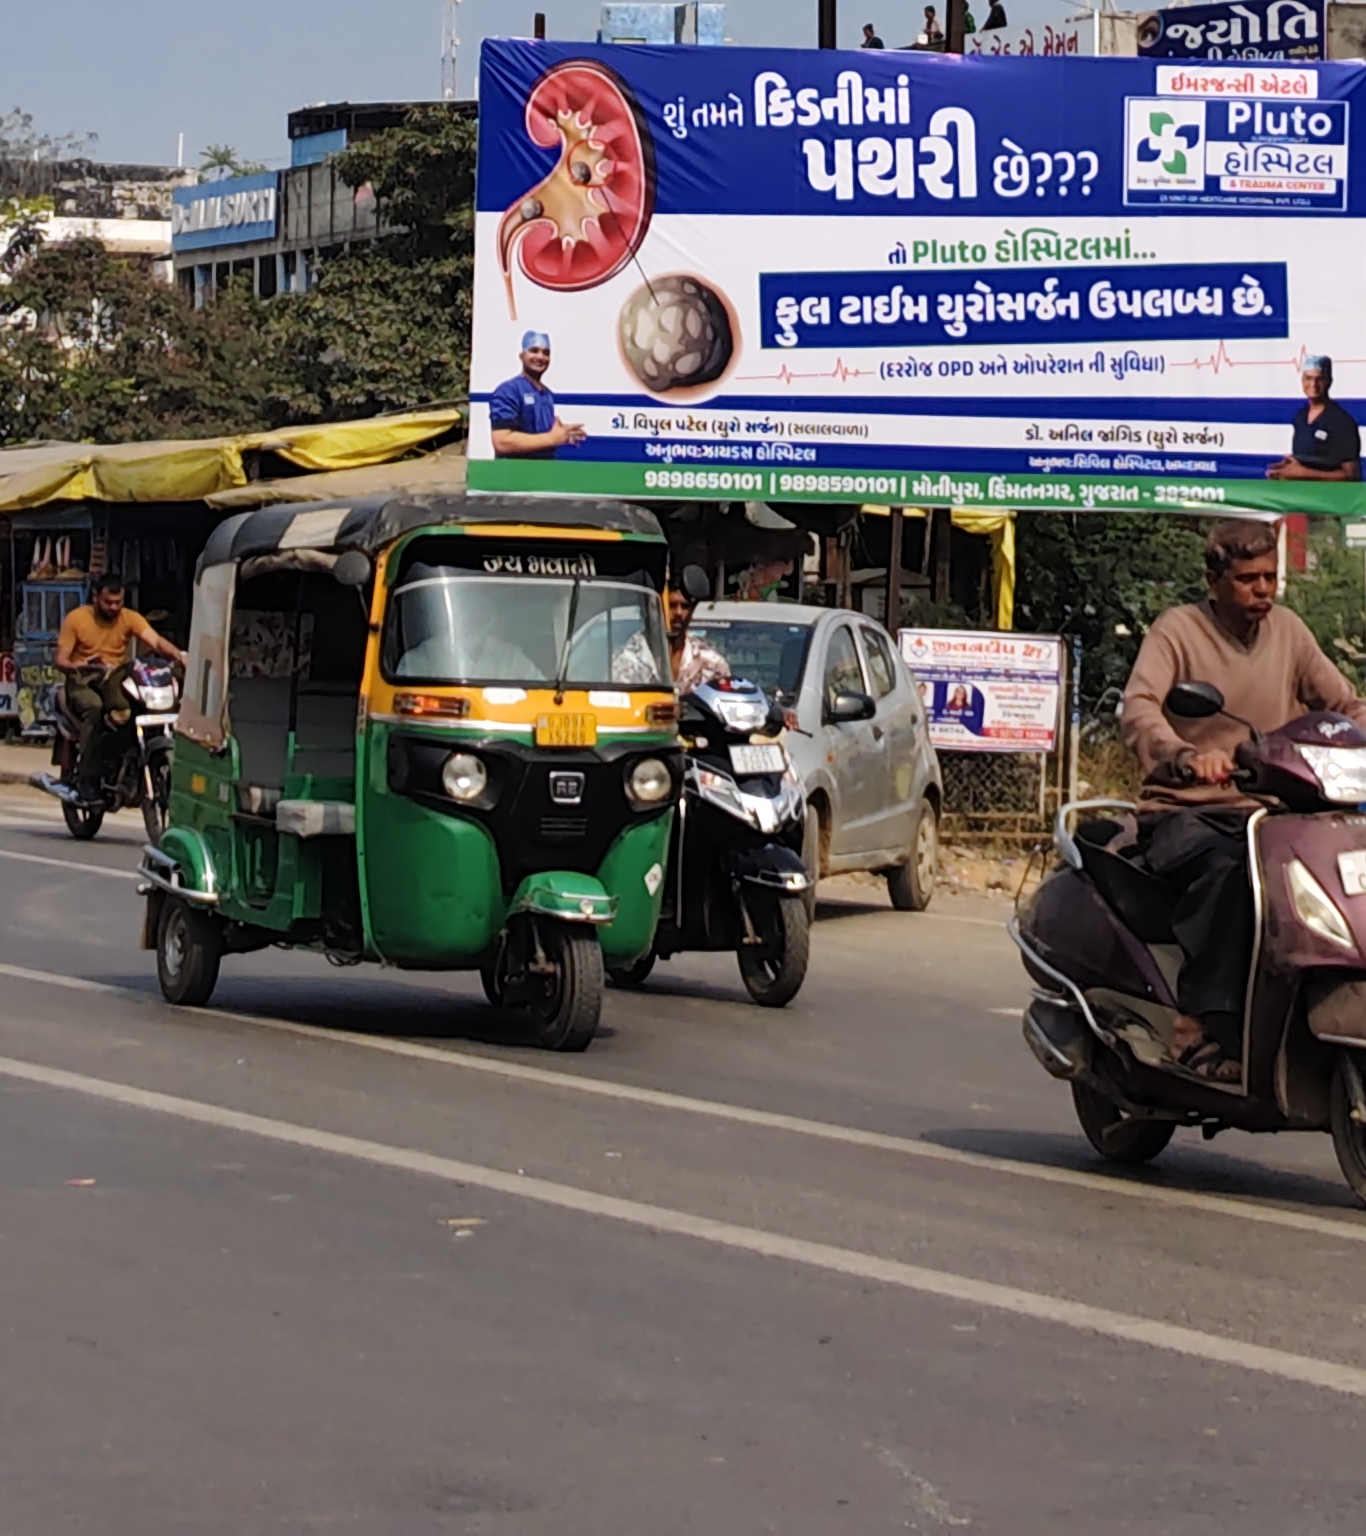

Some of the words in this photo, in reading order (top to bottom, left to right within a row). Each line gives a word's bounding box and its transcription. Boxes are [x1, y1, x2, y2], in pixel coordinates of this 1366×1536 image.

[1260, 72, 1309, 96] એટલે
[662, 102, 689, 139] શું
[692, 93, 745, 128] તમને
[754, 71, 911, 128] કિડનીમાં
[1228, 101, 1333, 137] Pluto
[802, 106, 978, 201] પથરી
[992, 137, 1100, 198] છે???
[1224, 141, 1334, 176] હોસ્પિટલ
[1239, 179, 1283, 191] TRAUMA
[1285, 179, 1326, 191] CENTER
[888, 242, 907, 265] તો
[912, 240, 987, 265] Pluto
[775, 296, 830, 346] ફુલ
[839, 286, 929, 326] ટાઈમ
[937, 277, 1080, 337] યુરોસર્જન
[1089, 280, 1223, 319] ઉપલબ્ધ
[1231, 274, 1274, 317] છે.
[879, 356, 934, 381] (દરરોજ
[938, 360, 973, 376] OPD
[978, 353, 1008, 376] અને
[1013, 353, 1084, 376] ઓપરેશન
[1088, 351, 1106, 373] ની
[1109, 349, 1165, 381] સુવિધા)
[633, 413, 672, 436] વિપુલ
[675, 415, 708, 432] પટેલ
[711, 417, 741, 438] (યુરો
[1048, 423, 1093, 443] અનિલ
[1146, 428, 1178, 449] (યુરો
[644, 470, 763, 491] 9898650101
[779, 475, 898, 495] 9898590101
[1078, 482, 1140, 505] ગુજરાત
